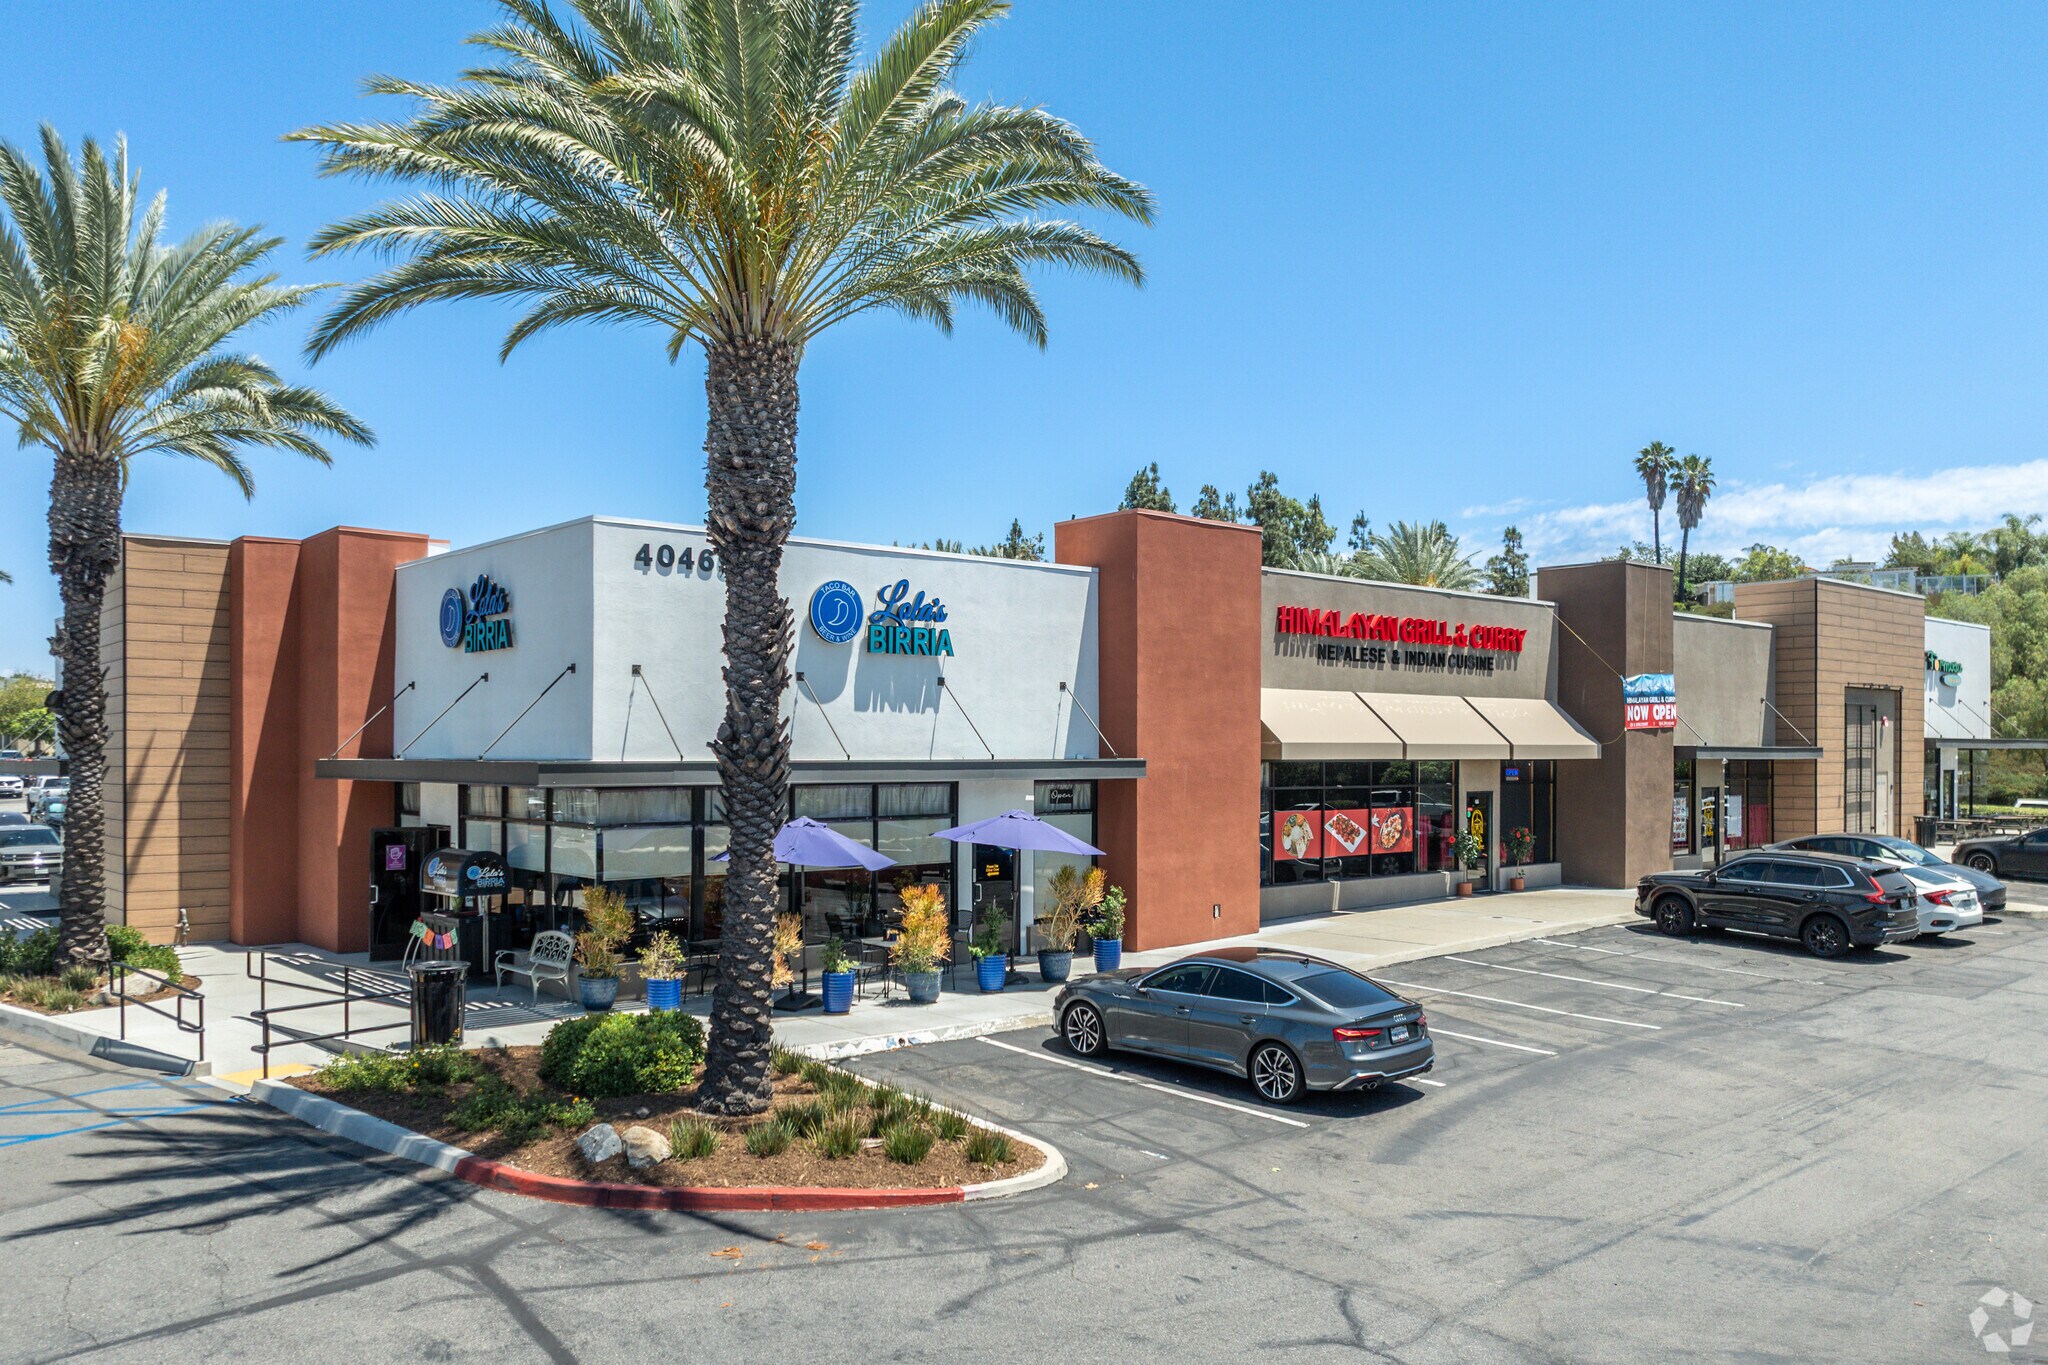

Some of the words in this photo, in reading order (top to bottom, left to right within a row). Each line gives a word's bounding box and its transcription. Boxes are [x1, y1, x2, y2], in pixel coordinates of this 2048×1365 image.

[635, 544, 716, 572] 4046
[821, 582, 840, 593] TACO
[841, 583, 856, 597] BAR
[870, 579, 948, 633] Lola's
[465, 619, 512, 653] BIRRIA
[818, 625, 835, 641] BEER
[842, 628, 857, 641] WINE
[867, 624, 955, 657] BIRRIA
[1277, 606, 1399, 642] HIMALAYAN
[1400, 617, 1452, 645] GRILL
[1453, 623, 1468, 648] &
[1469, 624, 1527, 653] CURRY
[1317, 643, 1386, 664] NEPALESE
[1391, 650, 1400, 665] &
[1405, 650, 1446, 668] INDIAN
[1447, 653, 1494, 671] CUISINE
[1627, 705, 1649, 721] NOW
[1653, 704, 1677, 720] OPEN
[1051, 790, 1073, 804] Open
